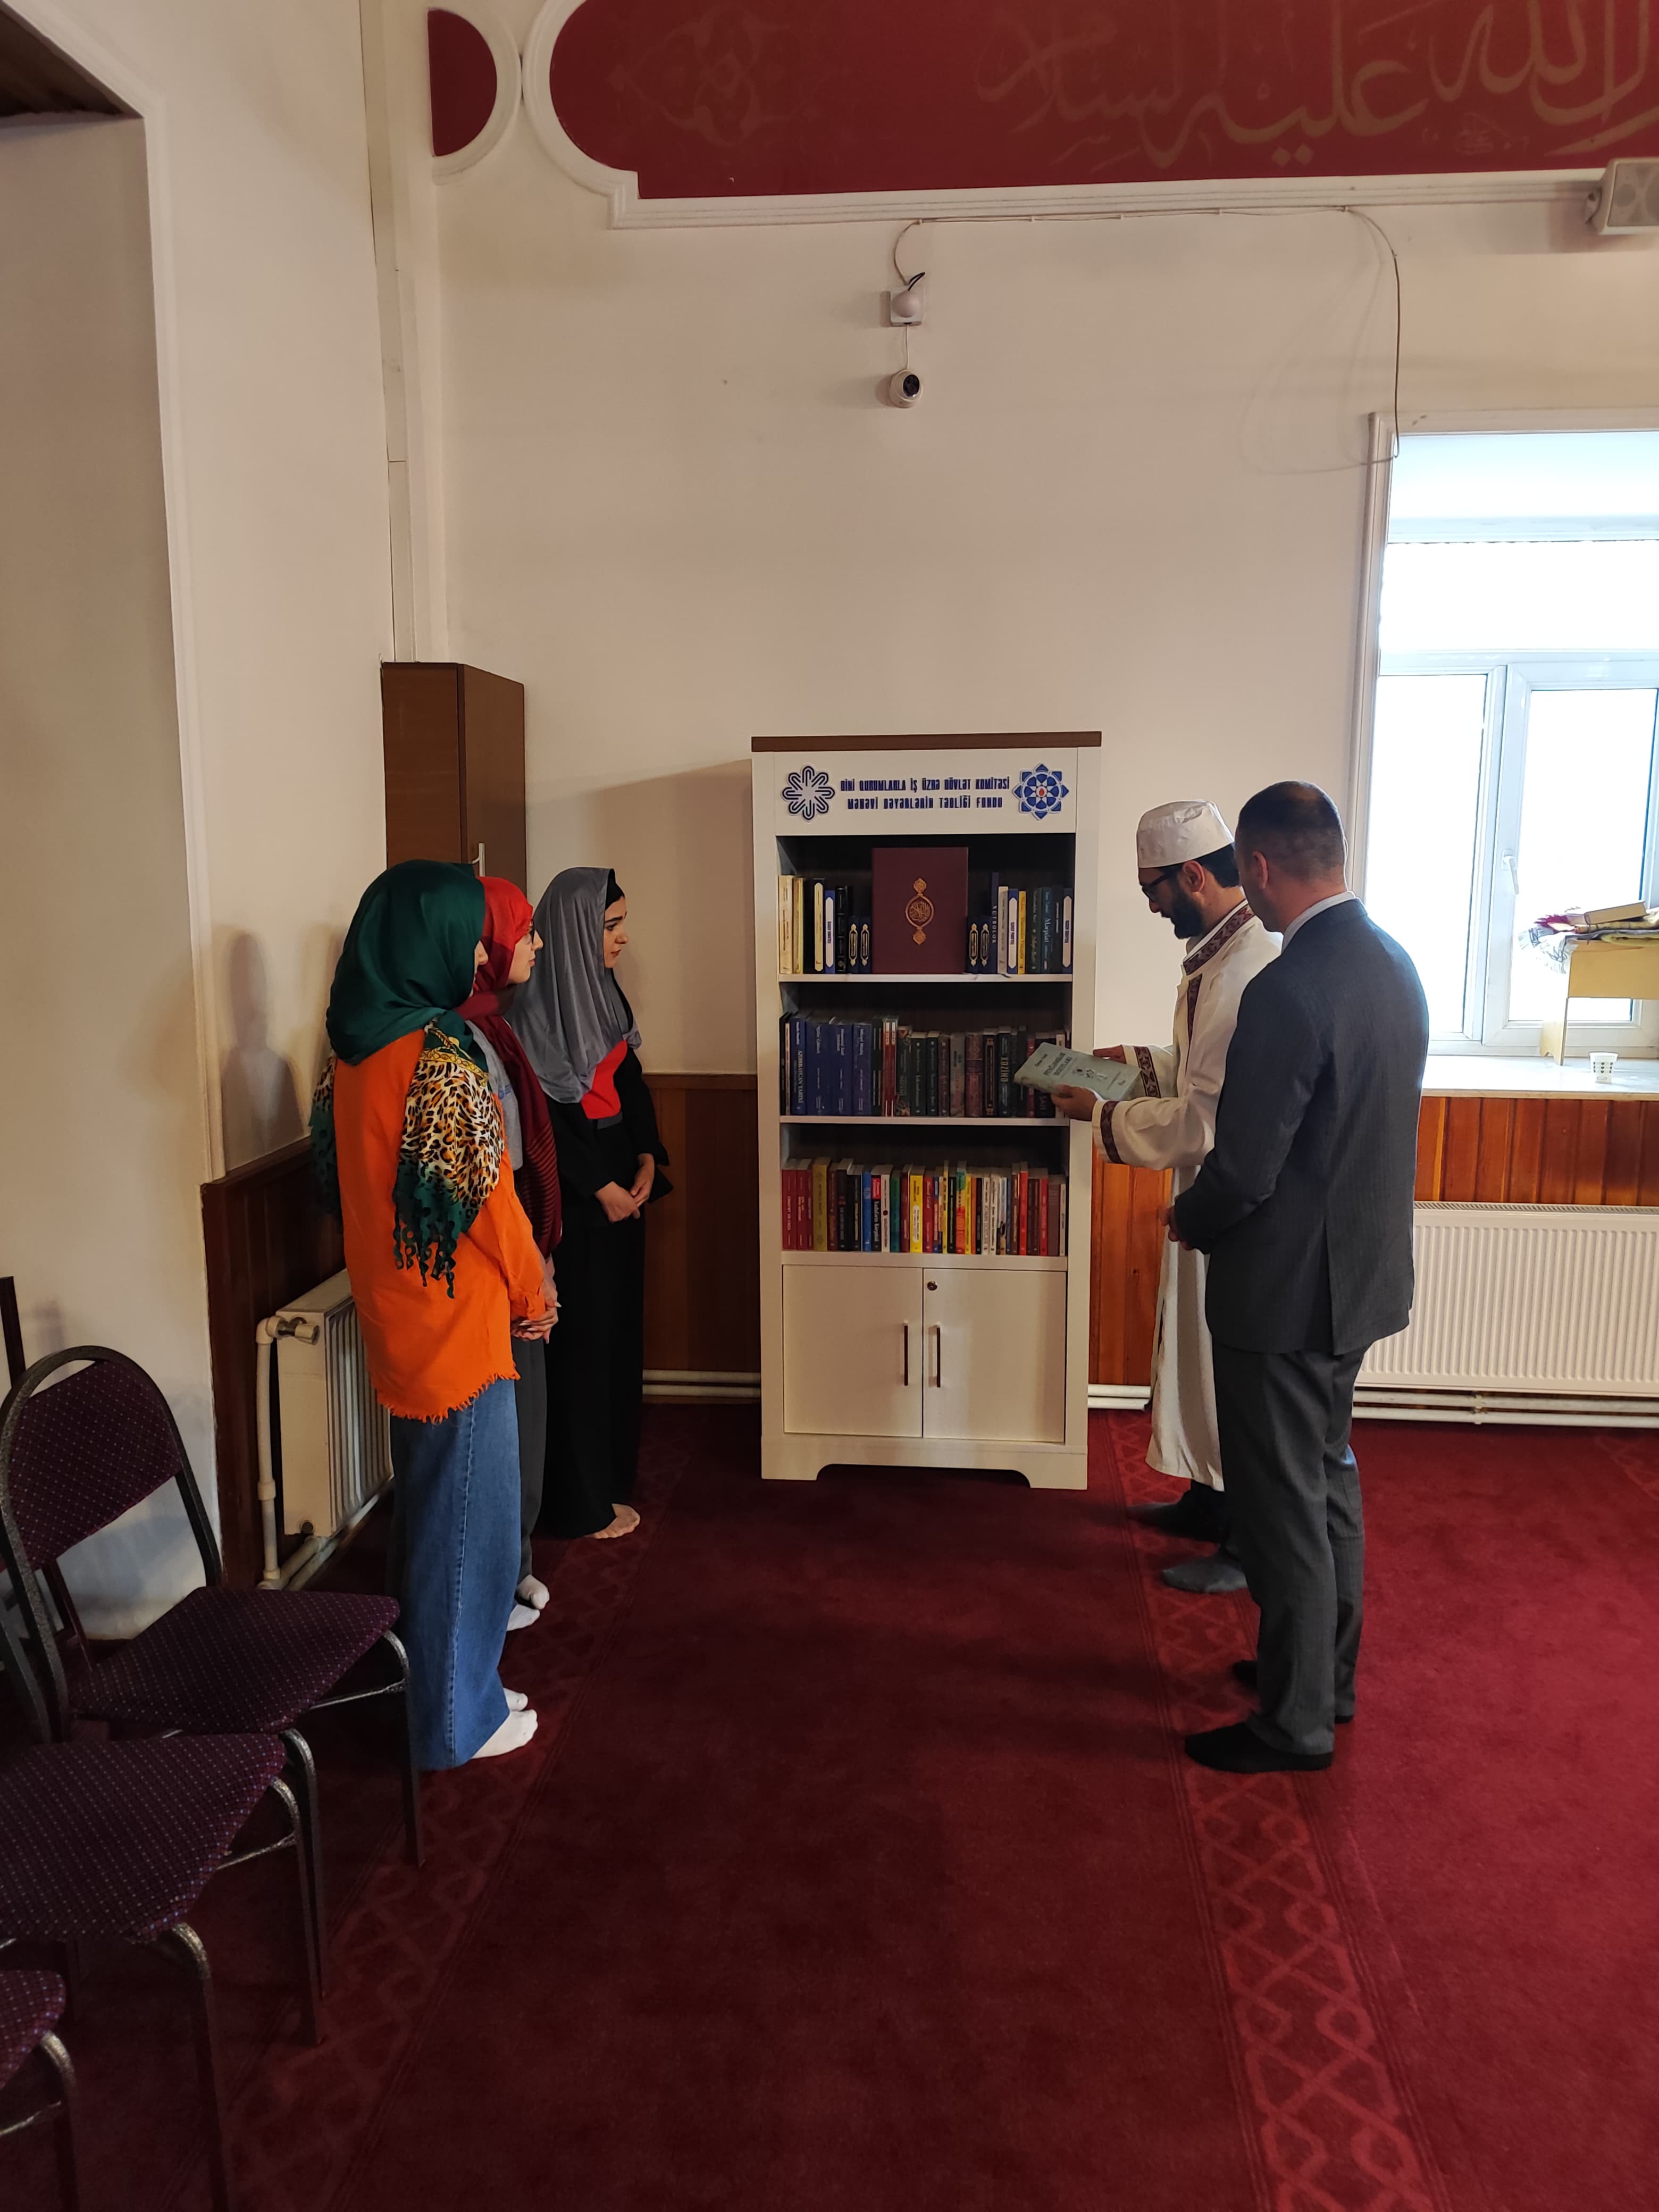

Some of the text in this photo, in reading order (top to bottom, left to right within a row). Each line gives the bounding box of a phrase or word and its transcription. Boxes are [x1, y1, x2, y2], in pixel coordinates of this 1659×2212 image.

[841, 778, 854, 791] DİNİ
[910, 777, 918, 793] İŞ
[976, 797, 1003, 808] FONDU
